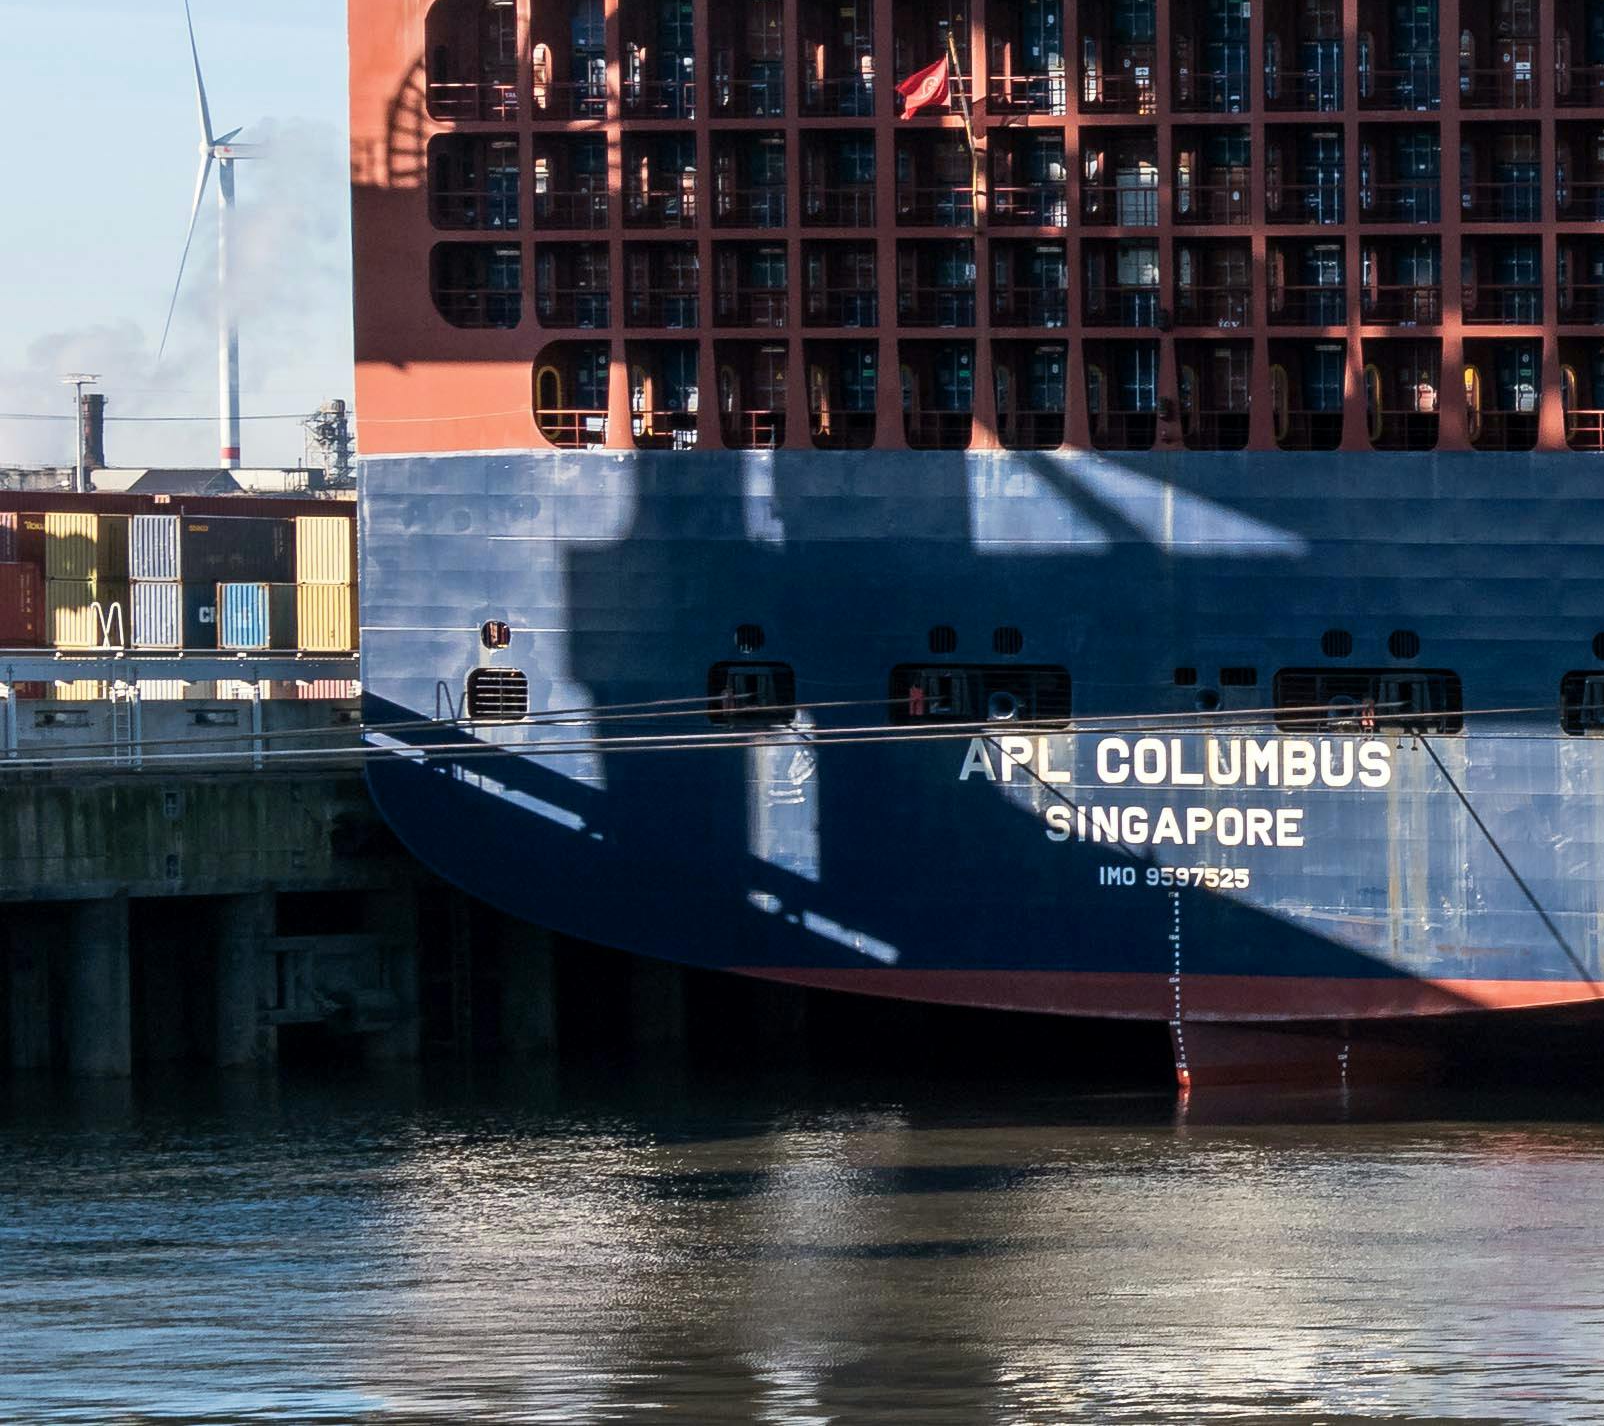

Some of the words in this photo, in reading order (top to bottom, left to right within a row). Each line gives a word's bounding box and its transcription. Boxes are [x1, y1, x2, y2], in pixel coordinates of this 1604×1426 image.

[958, 736, 1072, 784] APL
[1096, 737, 1392, 788] COLUMBUS
[1044, 805, 1305, 847] SINGAPORE
[1099, 866, 1136, 886] IMO
[1145, 867, 1250, 889] 9597525
